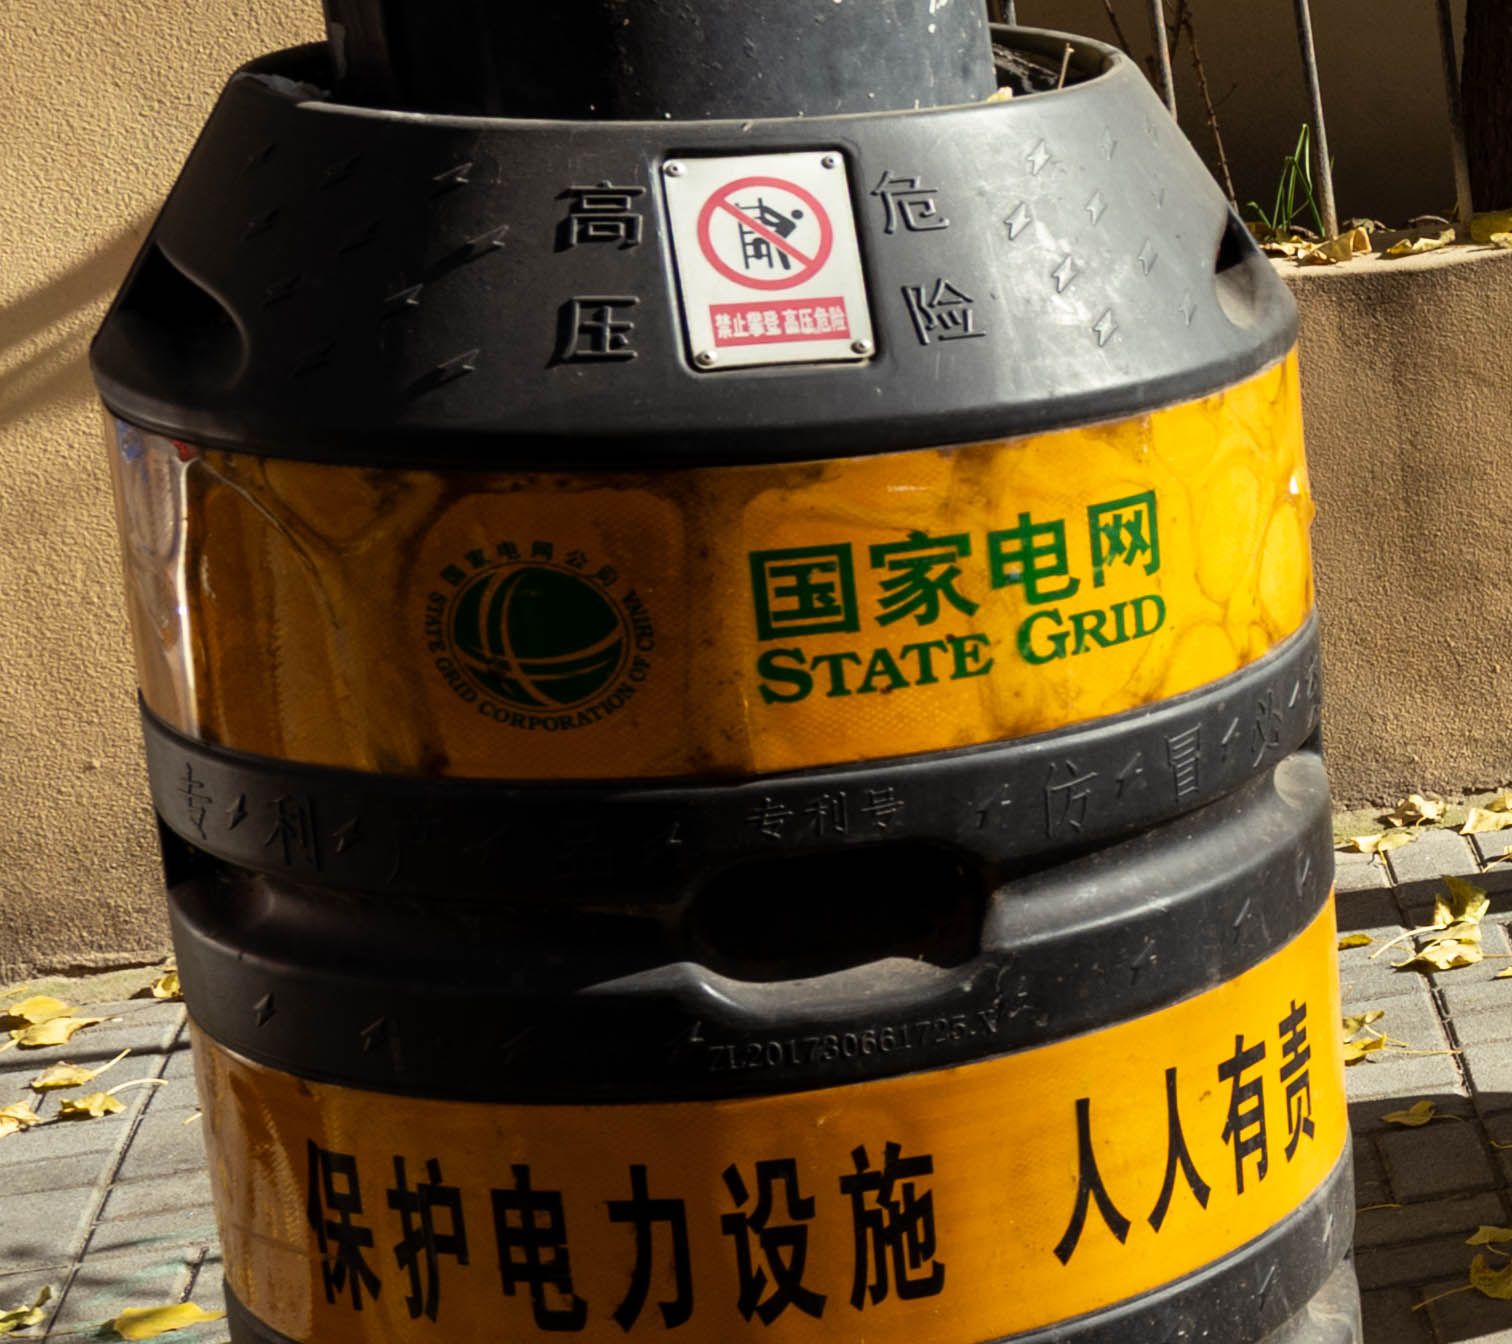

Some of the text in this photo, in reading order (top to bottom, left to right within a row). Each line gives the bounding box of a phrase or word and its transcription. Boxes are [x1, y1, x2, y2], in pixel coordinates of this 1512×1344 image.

[714, 304, 848, 339] 禁止攀登 高压危险
[870, 169, 987, 346] 危险
[748, 489, 1161, 643] 国家电网
[425, 588, 656, 733] STATE GRID CORPORATION OF CHINA
[306, 999, 1316, 1333] 保护电力设施 人人有责
